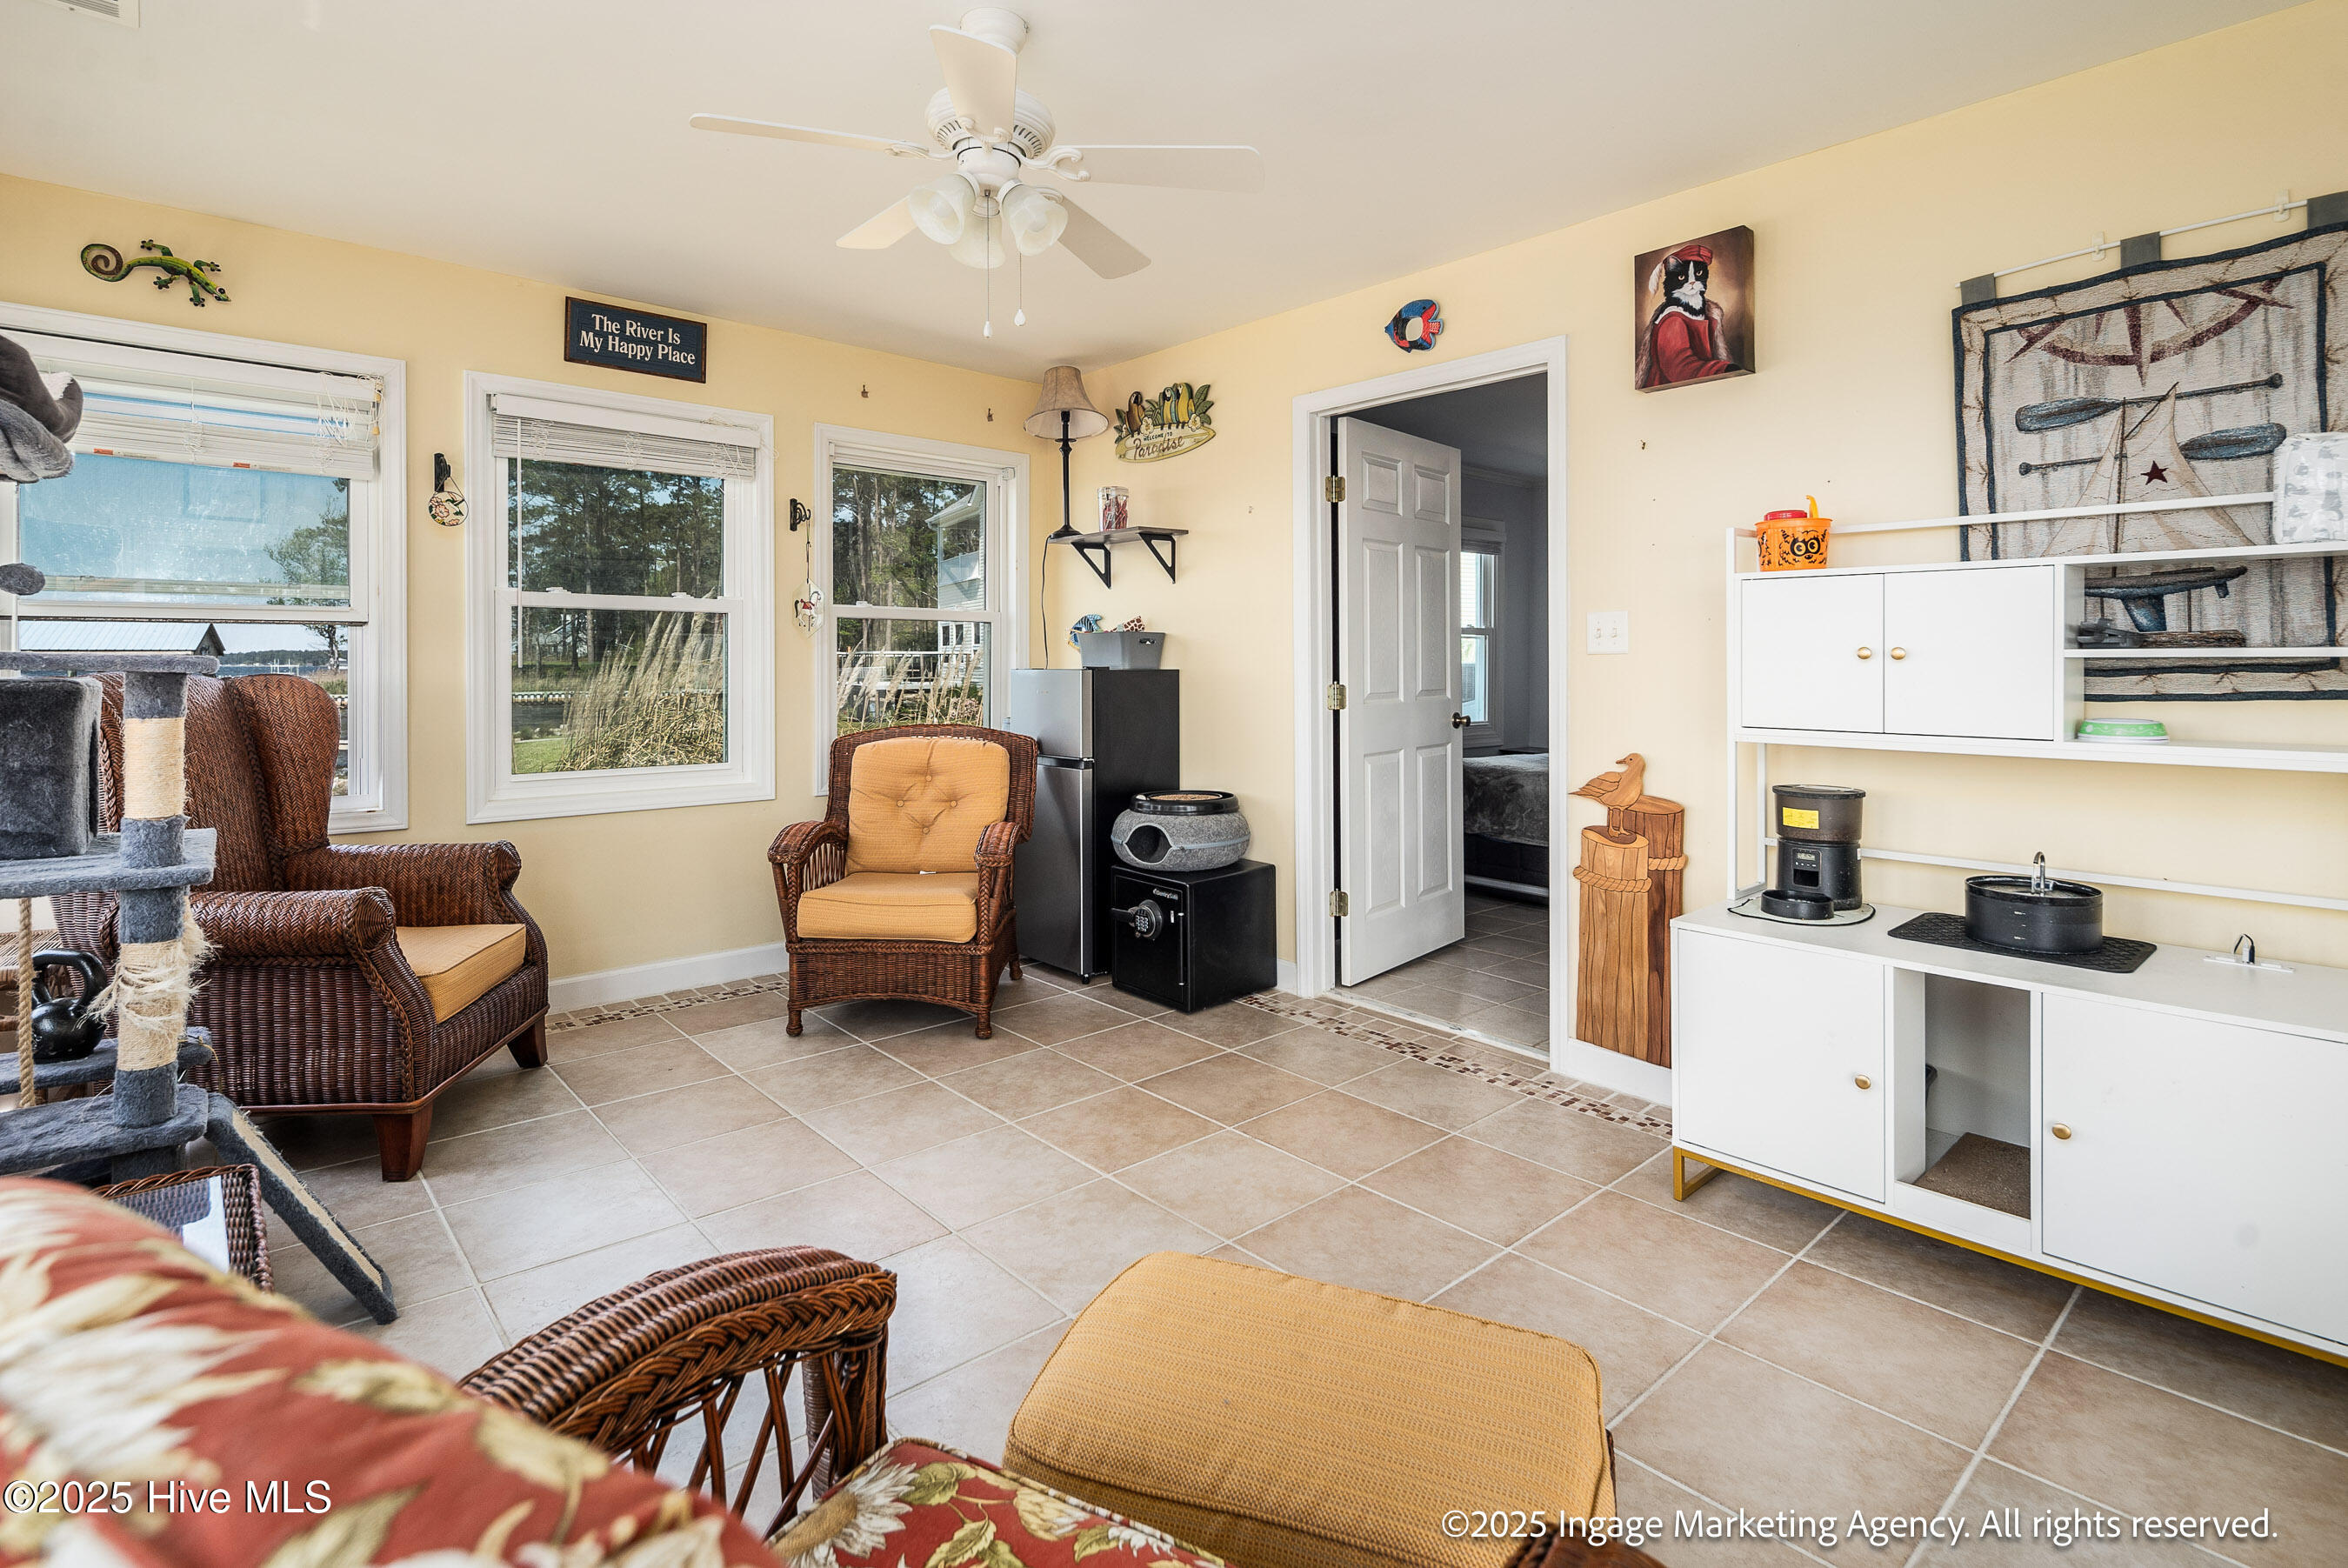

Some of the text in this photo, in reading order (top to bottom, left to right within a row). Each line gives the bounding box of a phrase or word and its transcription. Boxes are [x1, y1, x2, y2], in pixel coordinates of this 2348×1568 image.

[591, 314, 681, 345] The River Is
[579, 330, 696, 365] My Happy Place
[1133, 433, 1184, 460] Paradise
[1144, 432, 1164, 441] WELCOME
